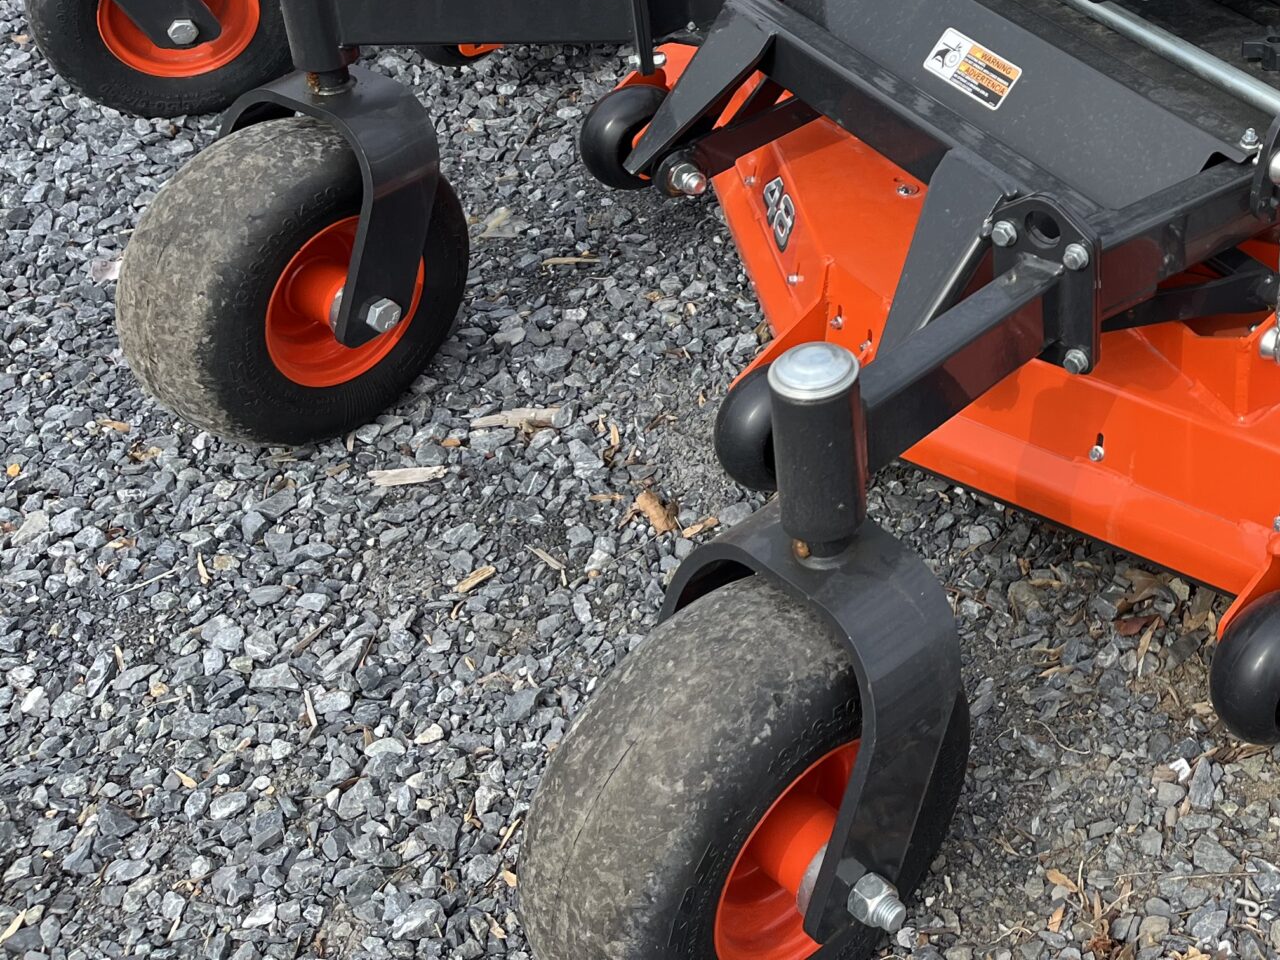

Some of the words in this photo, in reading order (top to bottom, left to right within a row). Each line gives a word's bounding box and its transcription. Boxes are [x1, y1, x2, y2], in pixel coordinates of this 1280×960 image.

[981, 52, 1012, 75] WARNING
[965, 66, 1006, 96] ADVERTENCIA
[763, 175, 796, 253] 48
